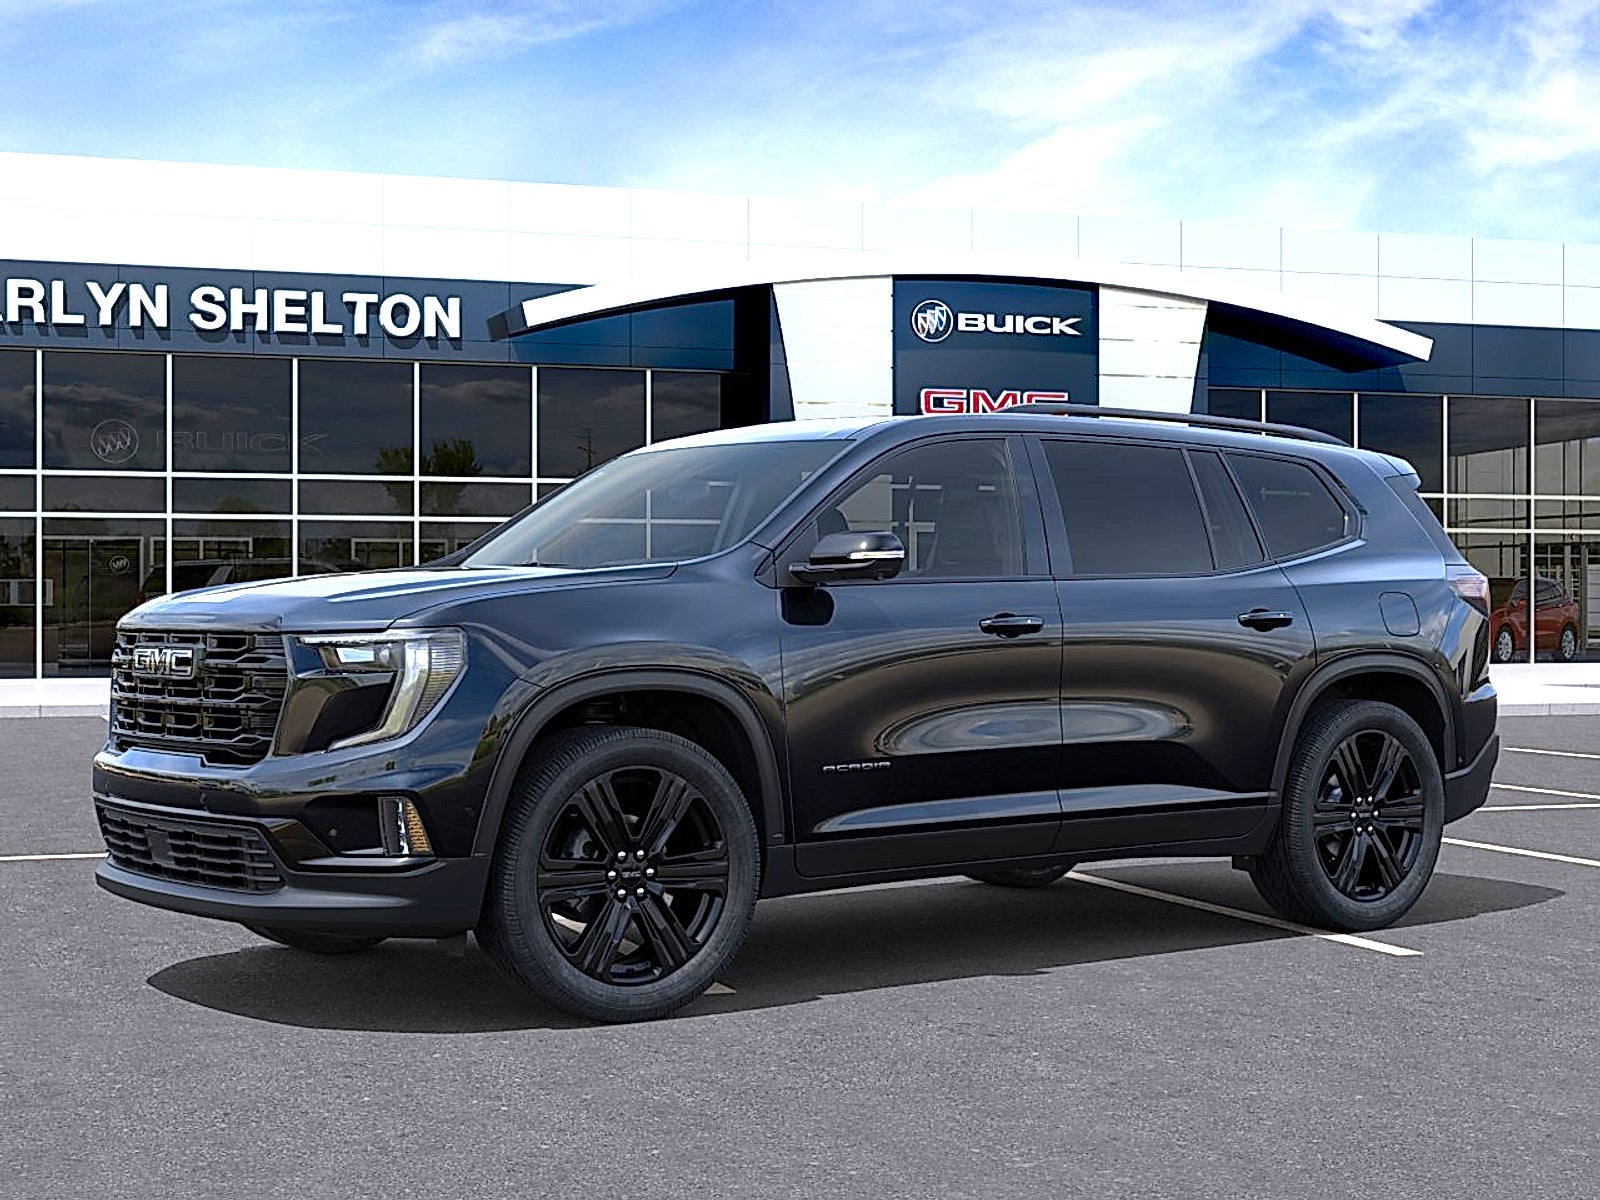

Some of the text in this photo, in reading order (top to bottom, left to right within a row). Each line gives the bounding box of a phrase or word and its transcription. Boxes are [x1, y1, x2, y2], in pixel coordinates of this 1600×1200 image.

[0, 278, 460, 338] RLYN SHELTON
[957, 312, 1081, 335] BUICK
[133, 648, 193, 675] GMC
